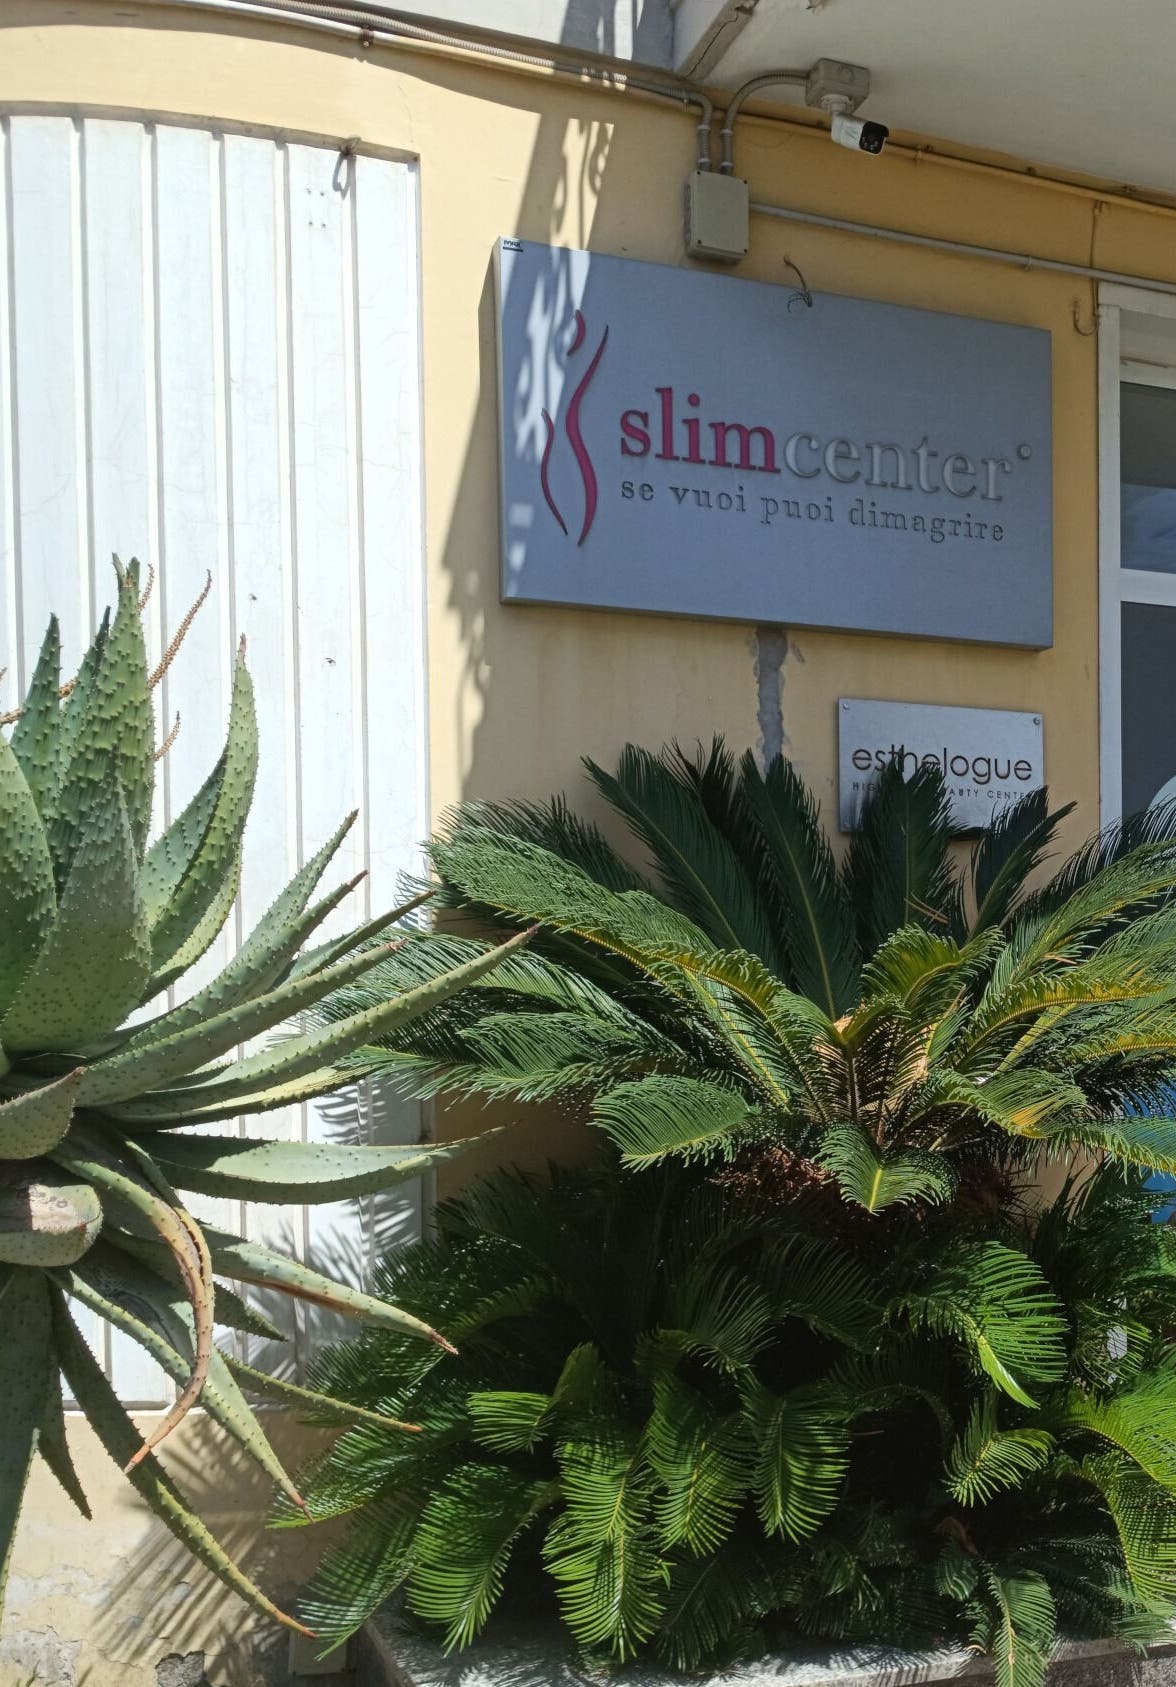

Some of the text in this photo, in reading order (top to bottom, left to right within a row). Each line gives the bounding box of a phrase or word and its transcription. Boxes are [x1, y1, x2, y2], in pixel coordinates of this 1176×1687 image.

[621, 480, 1006, 545] se vuoi puoi dimagrire
[852, 743, 1033, 786] esthelogue
[948, 788, 979, 798] AUTY
[986, 790, 1025, 800] CENTE
